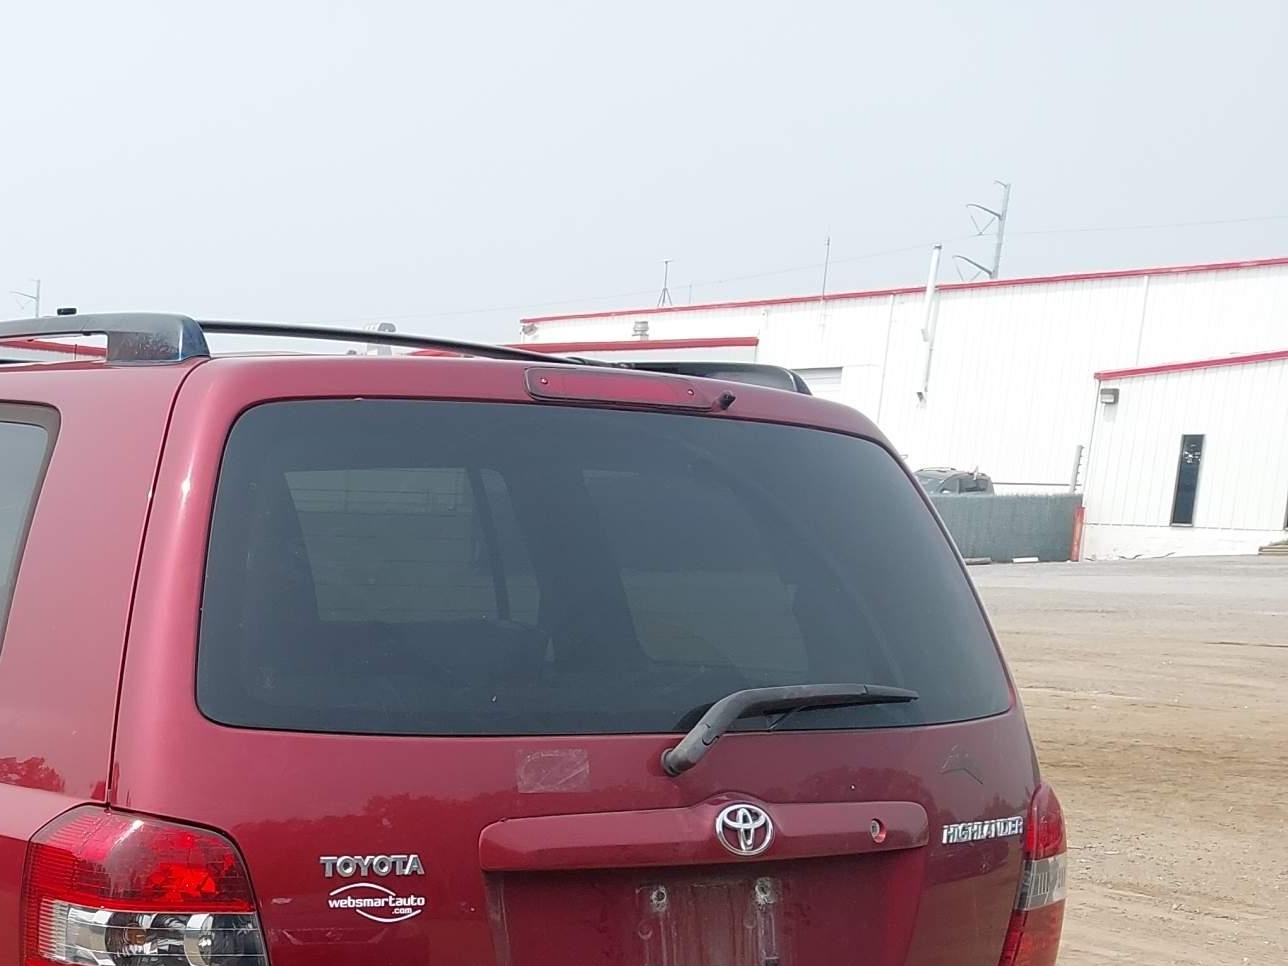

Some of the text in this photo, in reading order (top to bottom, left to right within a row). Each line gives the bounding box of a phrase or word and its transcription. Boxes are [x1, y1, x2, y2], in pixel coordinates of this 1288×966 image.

[942, 816, 1023, 844] HIGHLANDER
[320, 855, 425, 878] TOYOTA
[328, 895, 425, 908] websmartauto
[392, 907, 412, 915] .com
